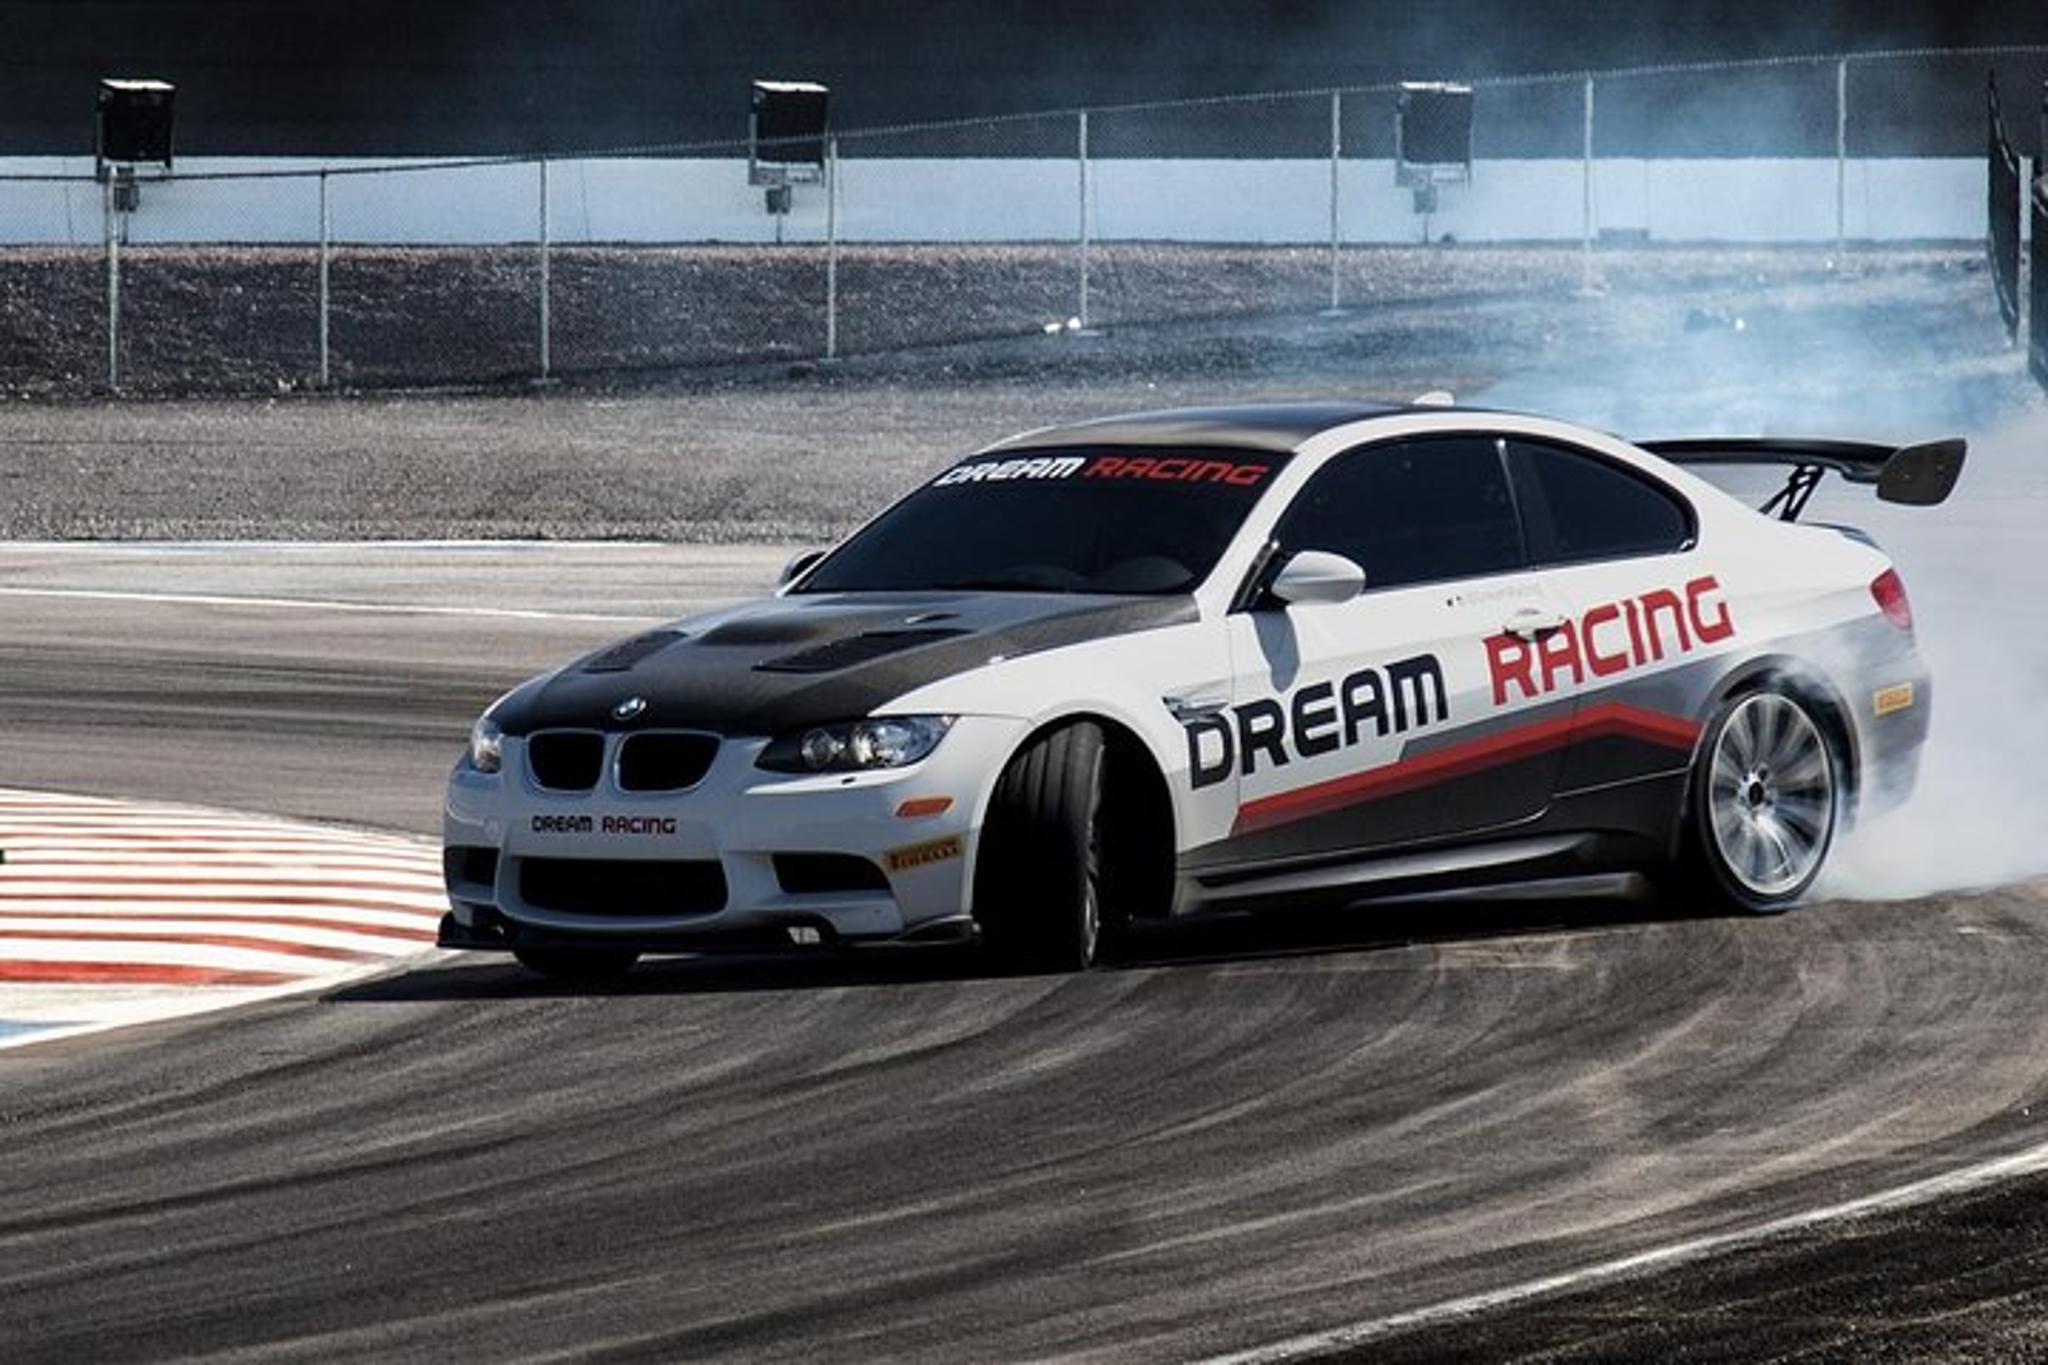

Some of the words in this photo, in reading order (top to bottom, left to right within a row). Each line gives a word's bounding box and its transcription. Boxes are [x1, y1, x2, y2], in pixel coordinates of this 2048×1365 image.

[934, 457, 1086, 487] DREAM
[1083, 457, 1268, 486] RACING
[1184, 653, 1449, 790] DREAM
[1483, 575, 1735, 705] RACING
[532, 815, 593, 833] DREAM
[602, 815, 677, 834] RACING
